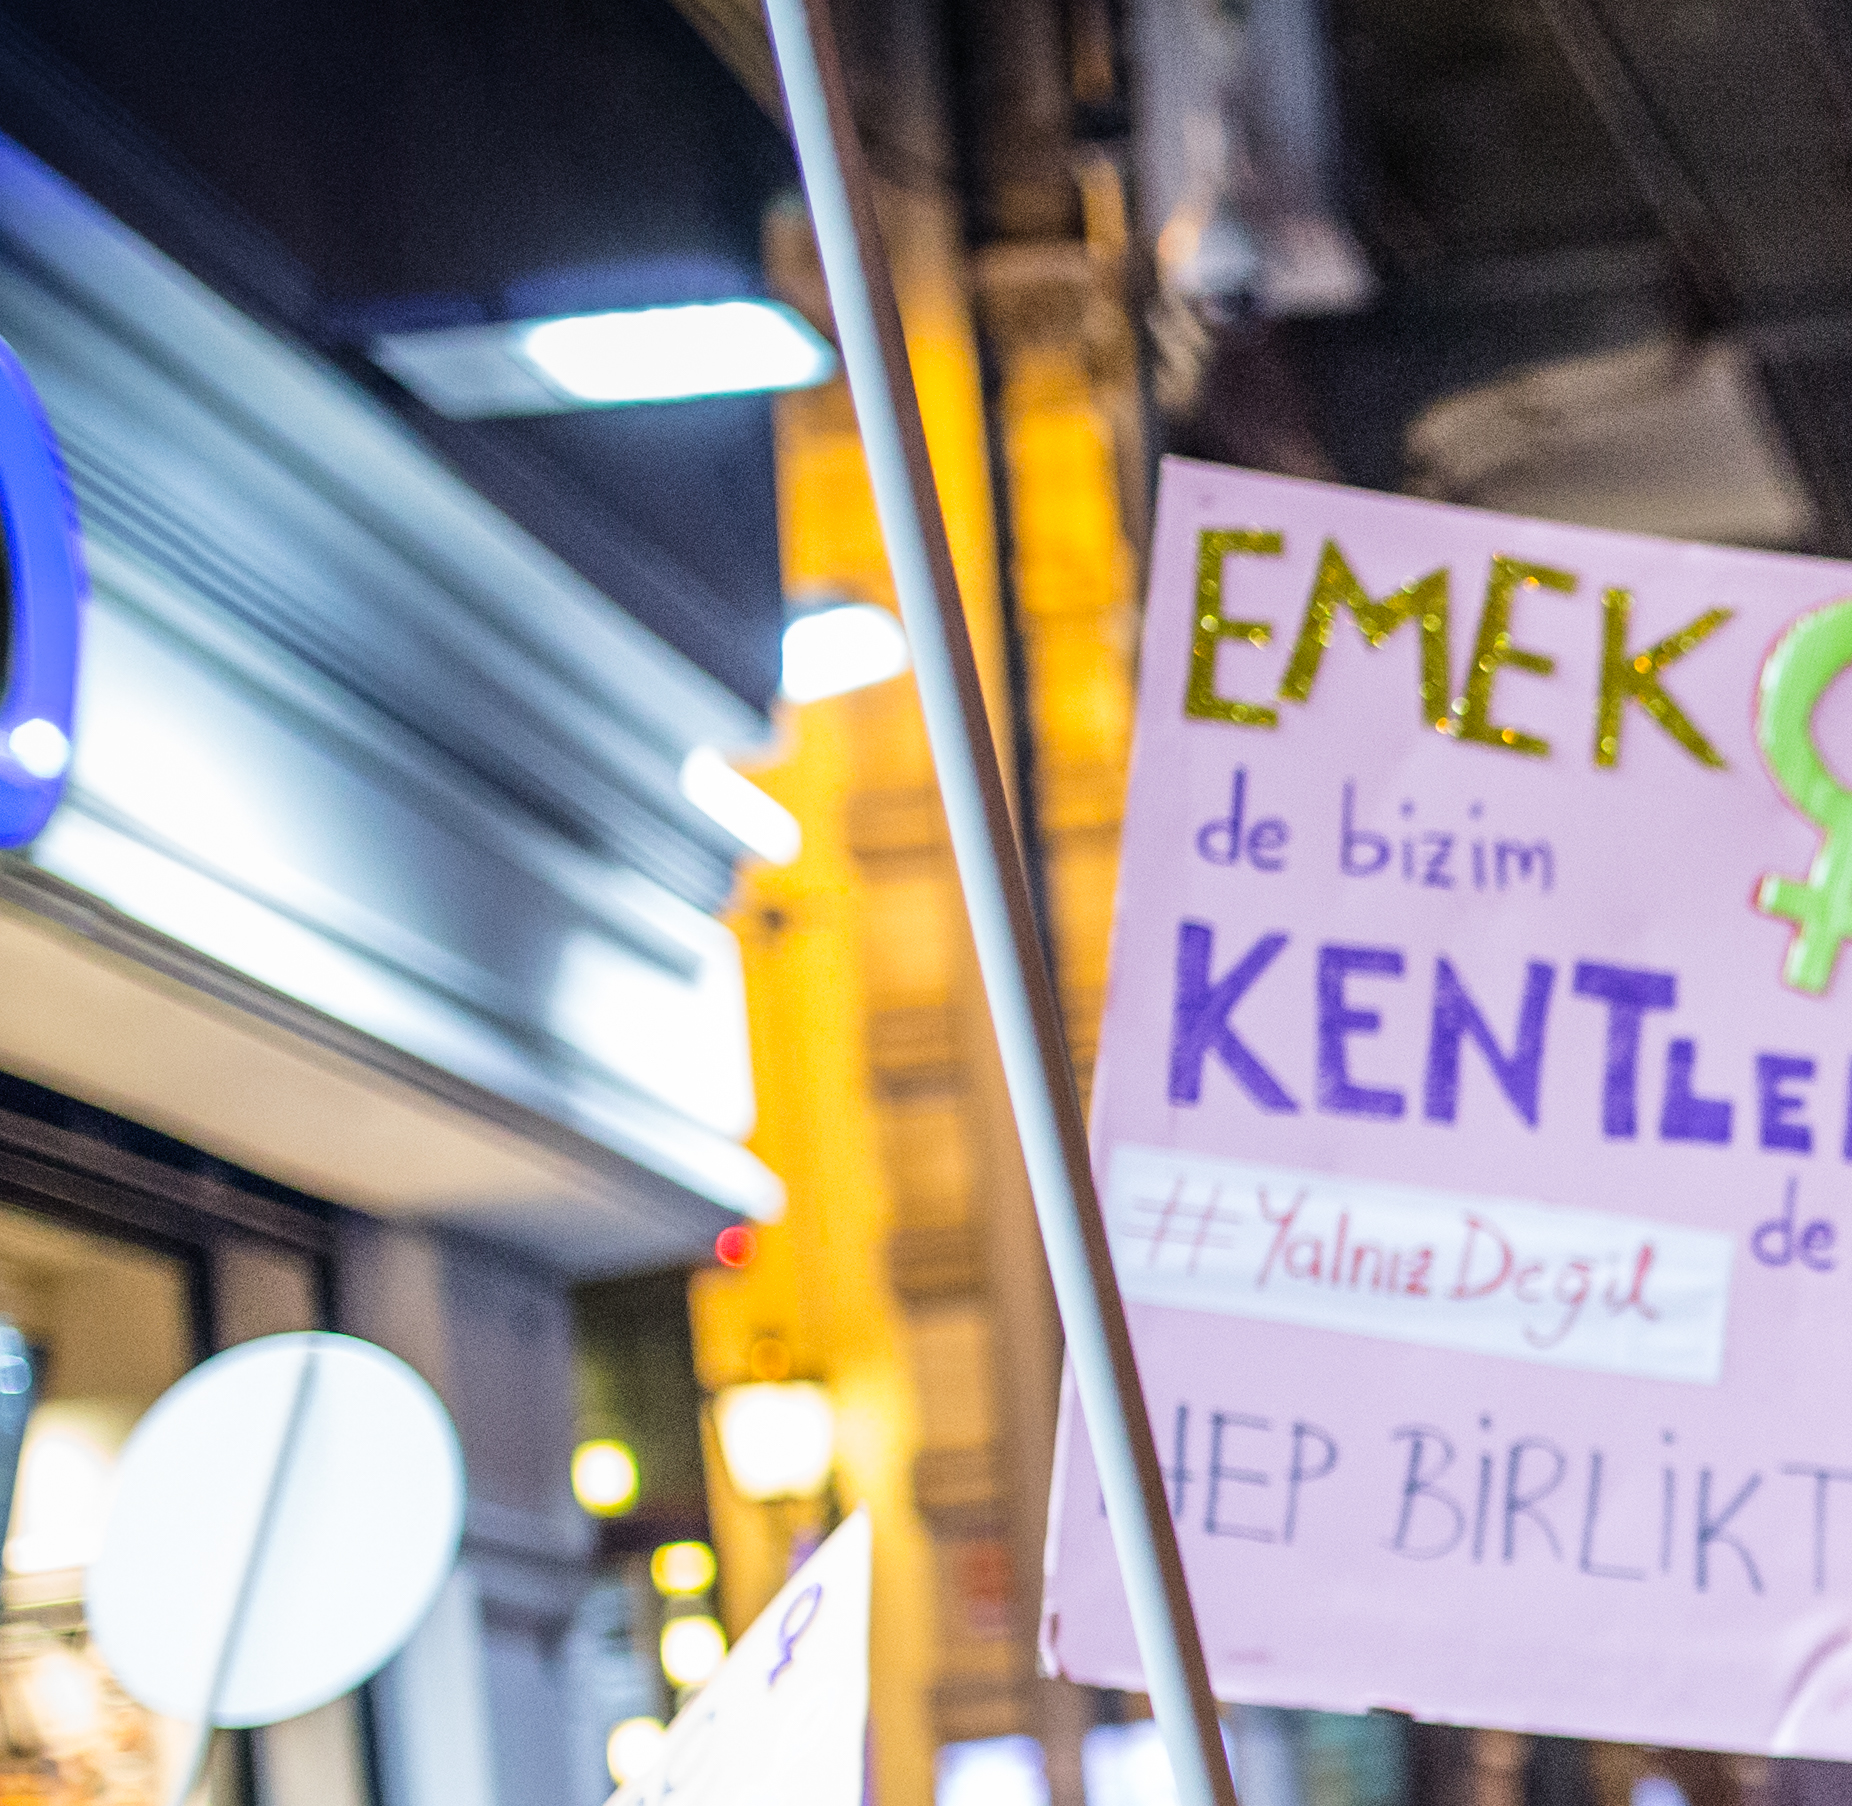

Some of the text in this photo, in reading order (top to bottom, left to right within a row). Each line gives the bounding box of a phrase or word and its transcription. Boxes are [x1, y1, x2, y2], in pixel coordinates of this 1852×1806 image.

[1184, 527, 1736, 771] EMEK
[1197, 765, 1556, 892] de bizim
